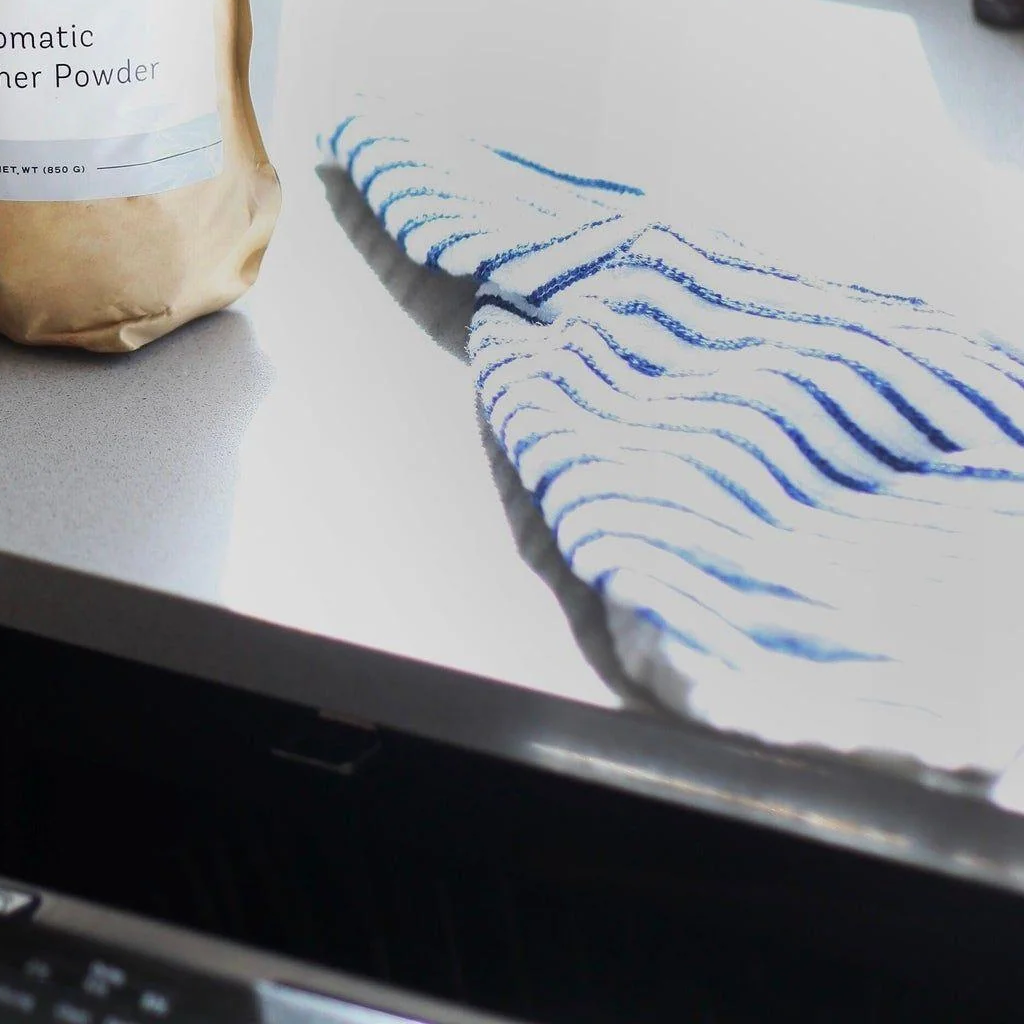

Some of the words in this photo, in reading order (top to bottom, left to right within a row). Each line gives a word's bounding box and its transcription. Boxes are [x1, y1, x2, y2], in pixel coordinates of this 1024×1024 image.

[55, 57, 160, 89] Powder
[42, 166, 68, 175] (850
[72, 165, 86, 174] G)
